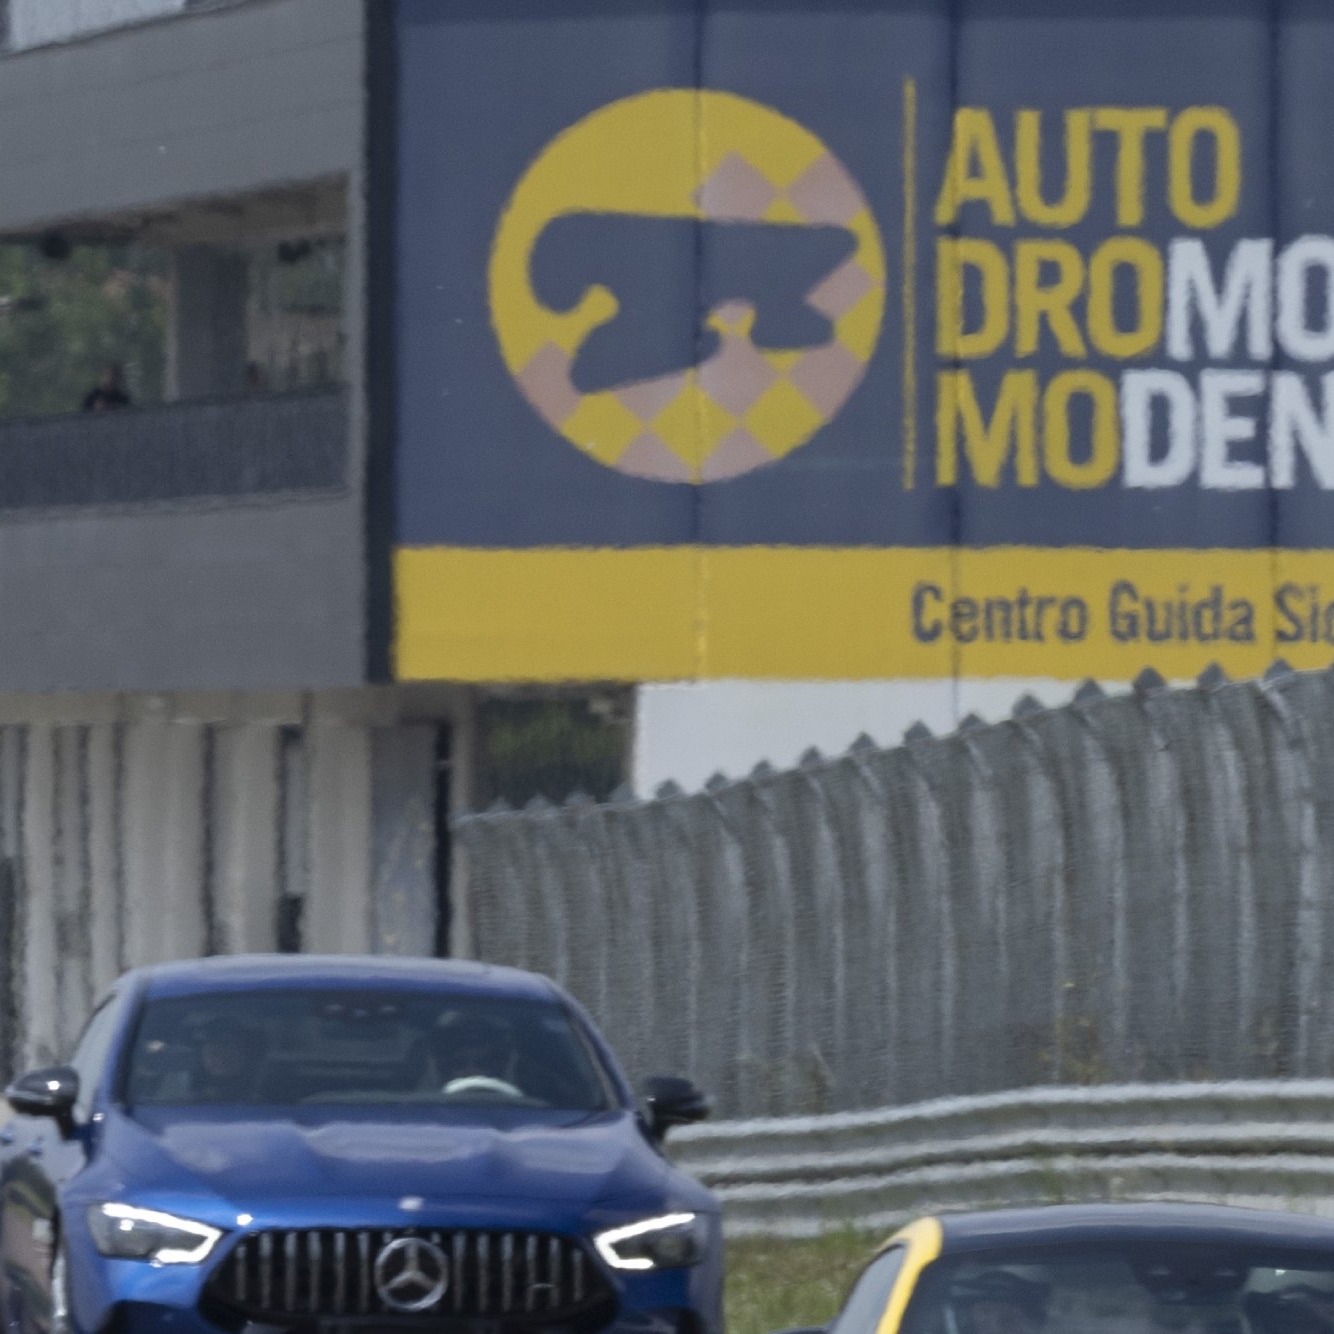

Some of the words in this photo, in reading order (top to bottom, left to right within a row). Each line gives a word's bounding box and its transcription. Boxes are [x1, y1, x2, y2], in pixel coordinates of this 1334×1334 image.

[934, 106, 1241, 229] AUTO
[911, 581, 1090, 644] Centro
[1109, 580, 1256, 645] Guida
